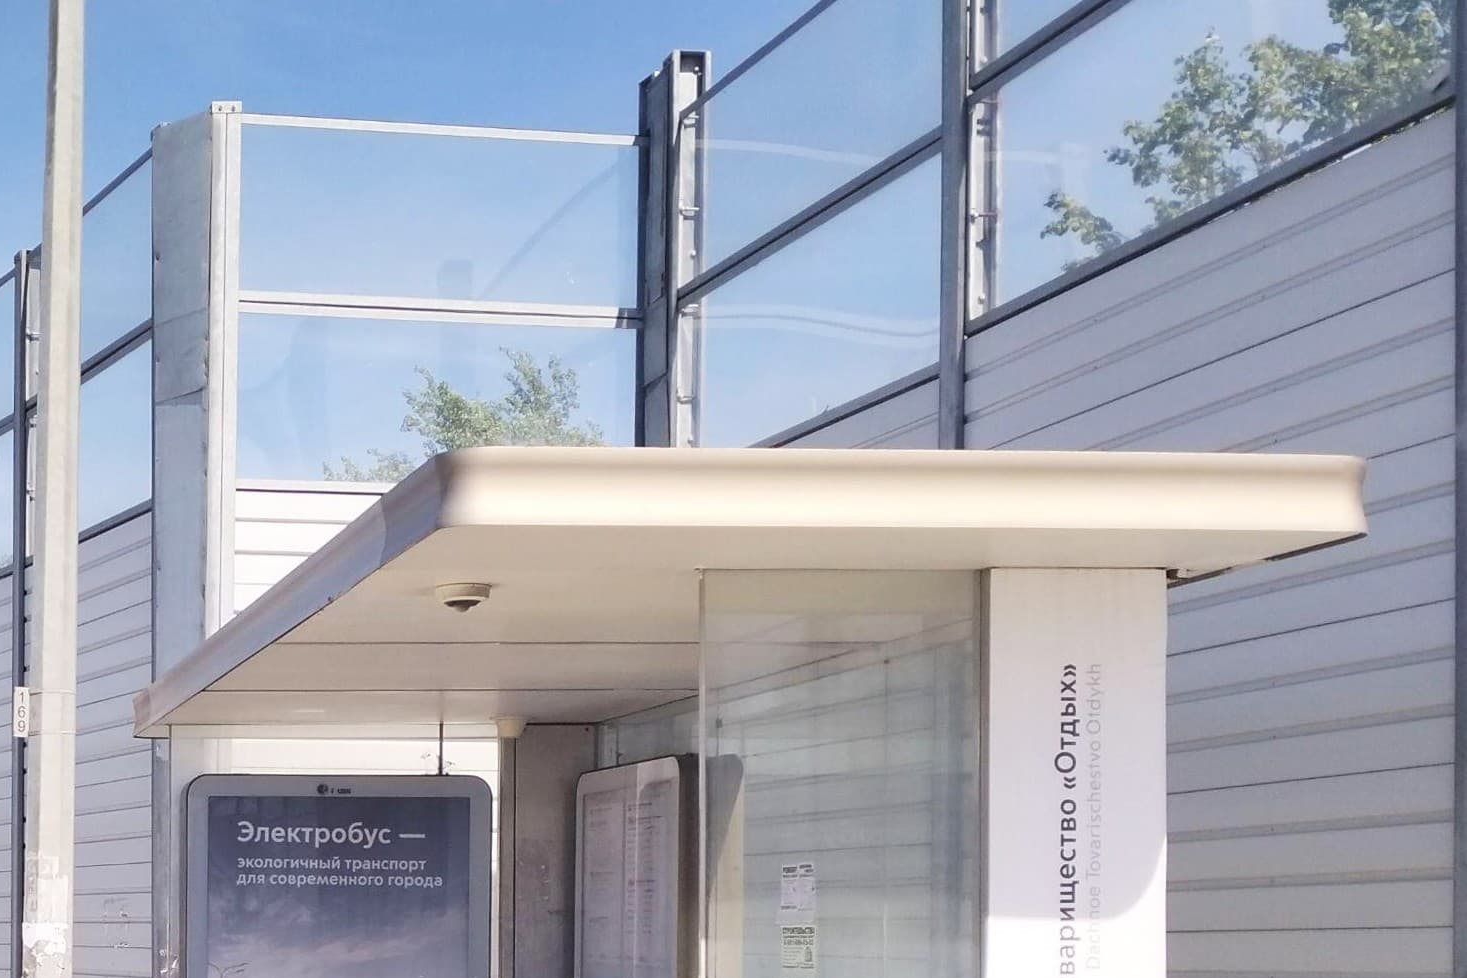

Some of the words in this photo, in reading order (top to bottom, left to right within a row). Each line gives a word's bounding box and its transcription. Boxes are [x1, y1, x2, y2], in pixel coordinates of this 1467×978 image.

[17, 692, 26, 732] 169
[1054, 663, 1080, 789] «Отдых»
[1086, 663, 1103, 735] Otdykh
[237, 820, 391, 848] Электробус
[1086, 741, 1101, 882] Tovarischestvo
[236, 874, 265, 886] для
[269, 874, 383, 887] современного
[388, 876, 443, 888] города
[237, 856, 341, 870] экологичный
[345, 858, 426, 872] транспорт
[1086, 887, 1101, 969] Dachnoe
